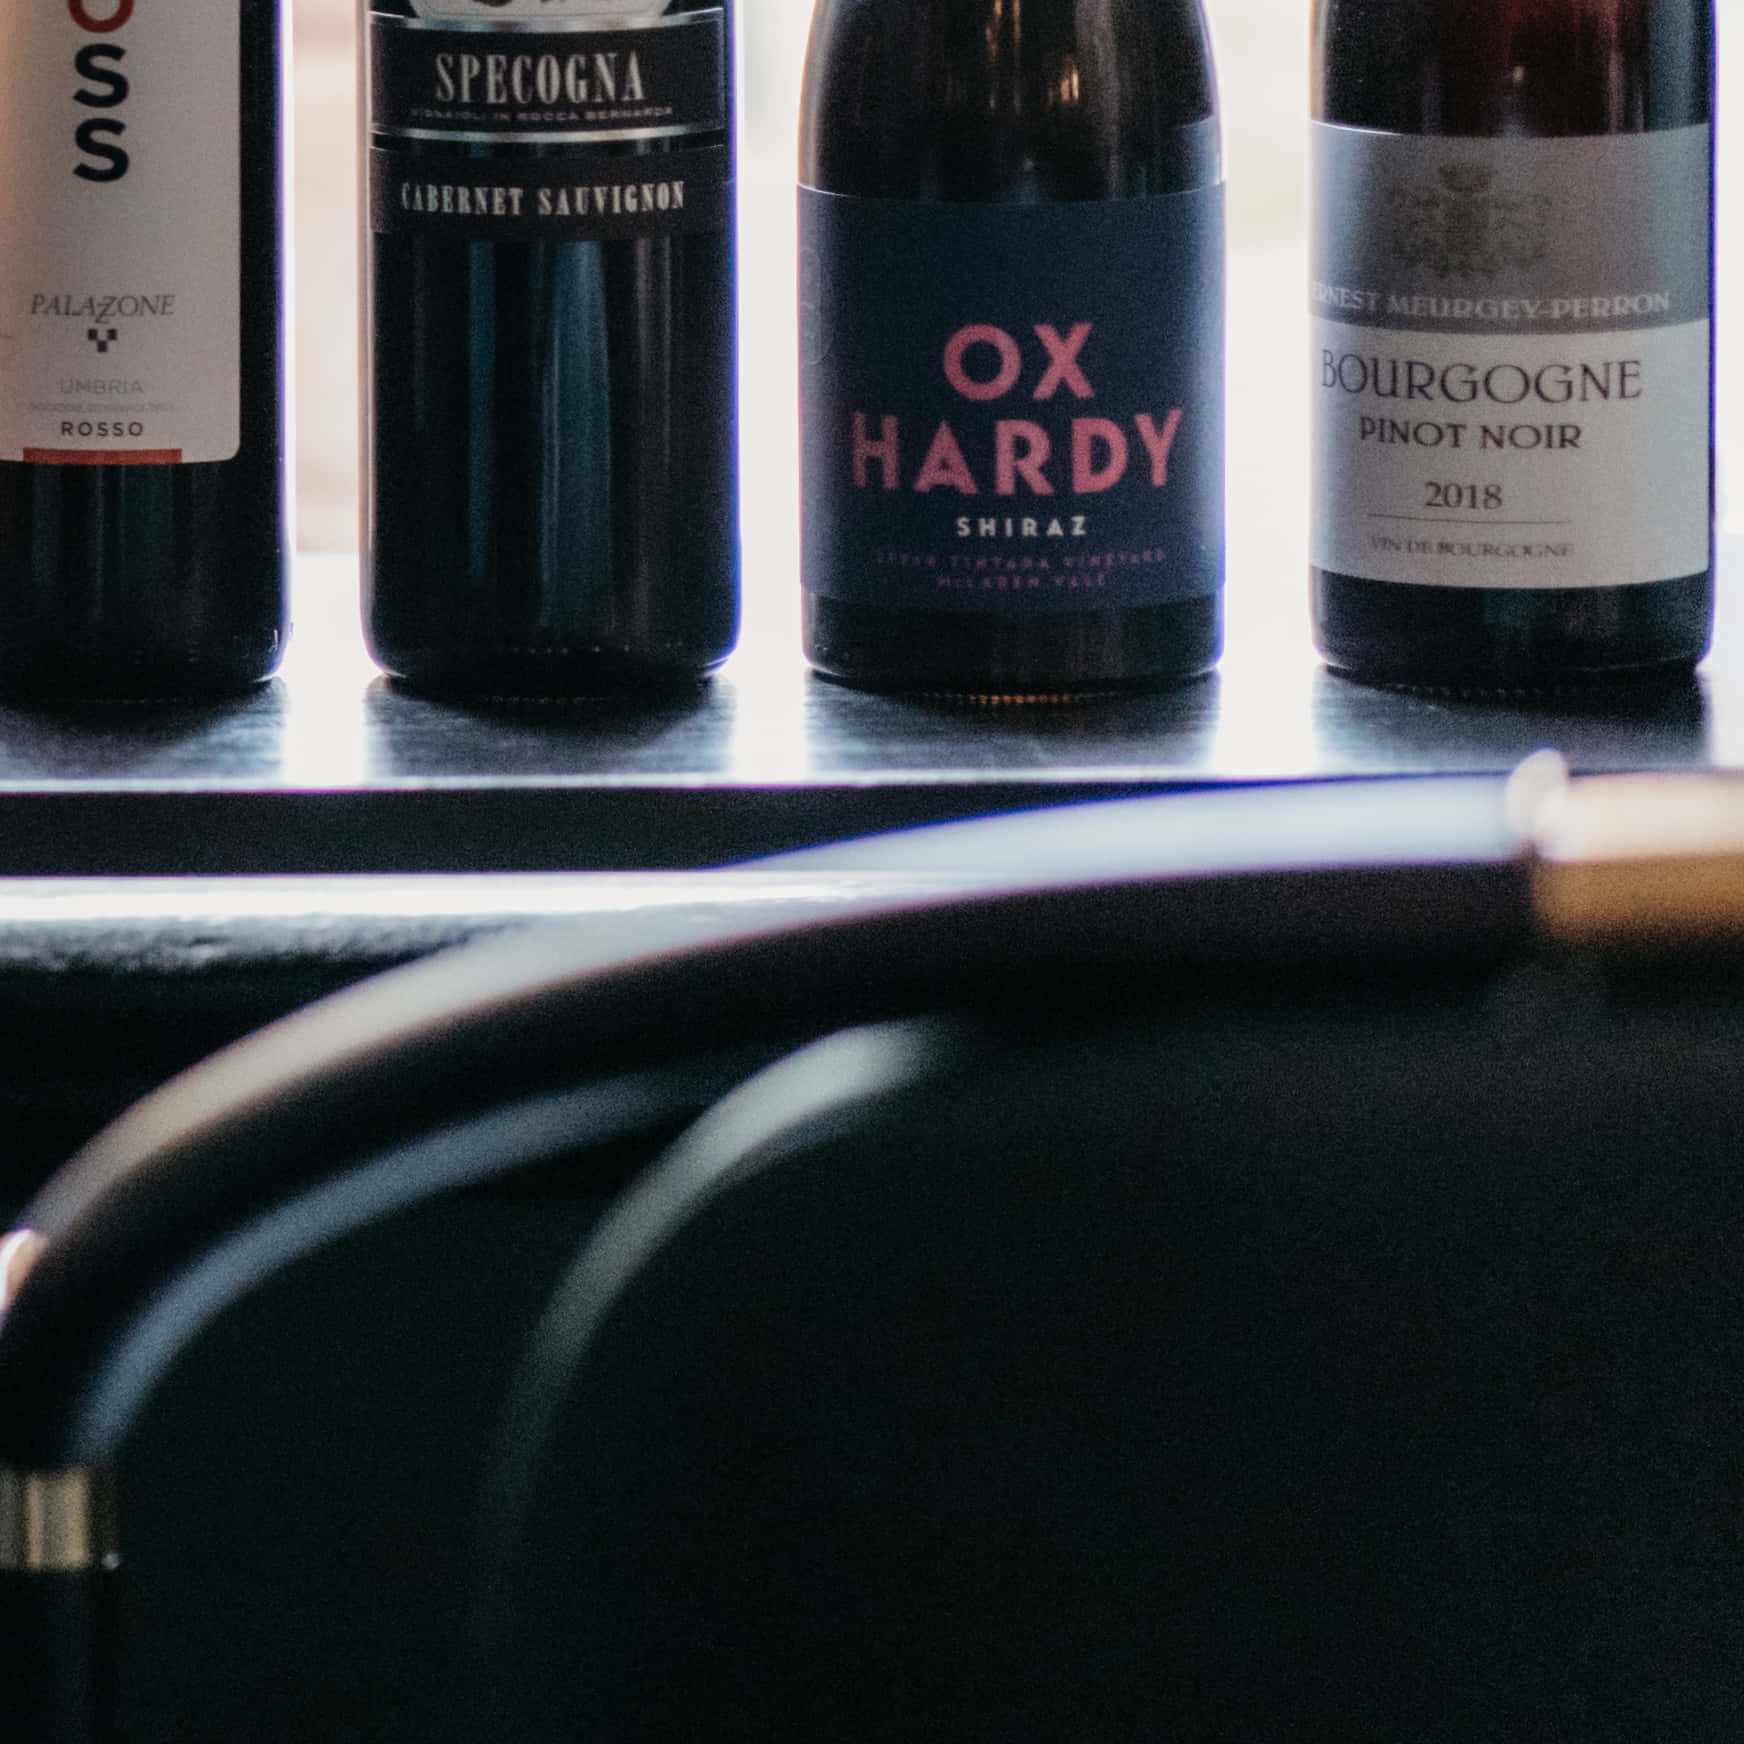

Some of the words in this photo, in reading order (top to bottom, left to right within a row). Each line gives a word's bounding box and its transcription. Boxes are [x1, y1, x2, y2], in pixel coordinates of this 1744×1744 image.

[434, 51, 647, 105] SPECOGNA
[401, 182, 523, 217] CABERNET
[538, 180, 685, 216] SAUVIGNON
[943, 322, 1095, 400] OX
[1321, 349, 1642, 403] BOURGOGNE
[60, 421, 144, 437] ROSSO
[1359, 416, 1467, 448] PINOT
[1479, 423, 1582, 450] NOIR
[852, 409, 1183, 496] HARDY
[1425, 480, 1504, 511] 2018
[956, 515, 1088, 537] SHIRAZ
